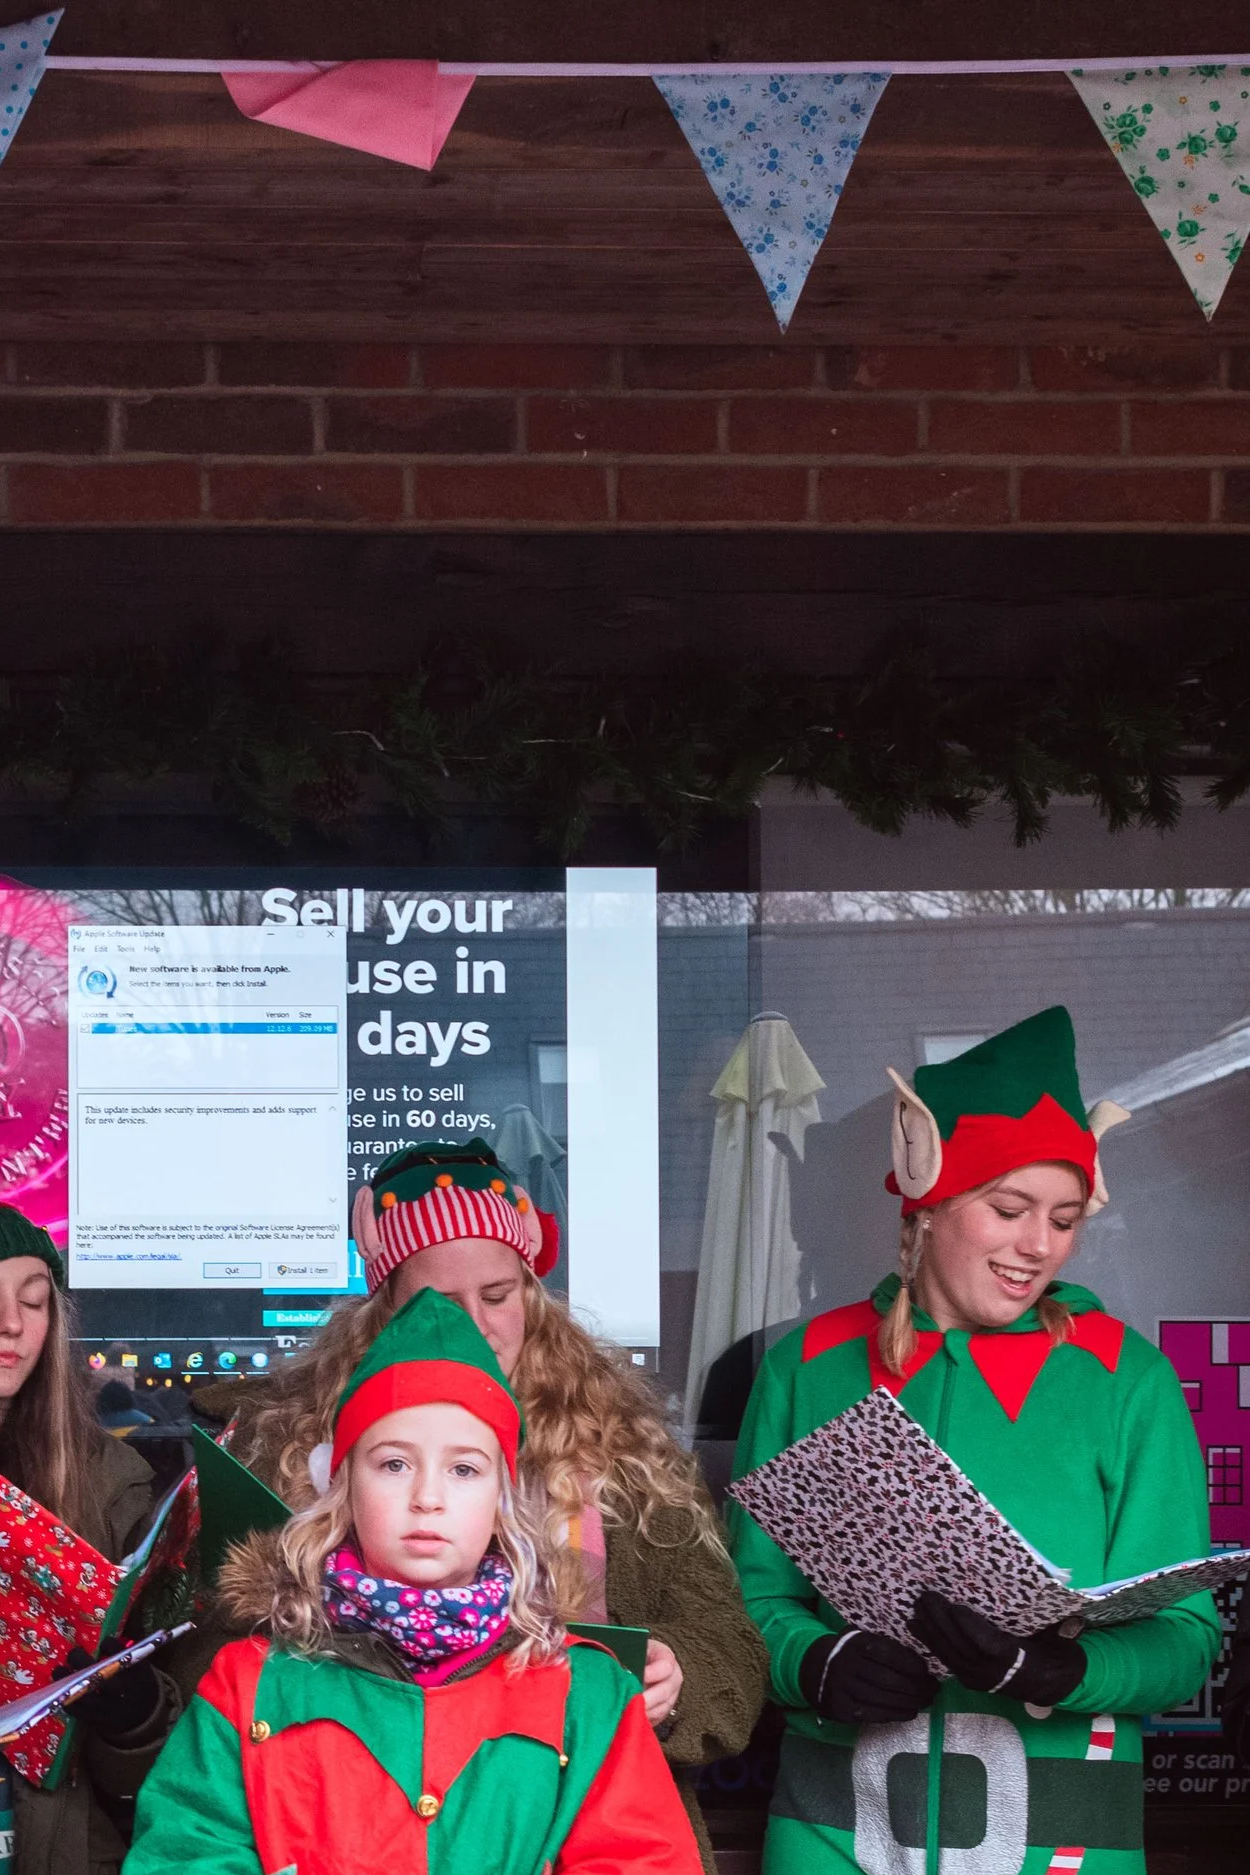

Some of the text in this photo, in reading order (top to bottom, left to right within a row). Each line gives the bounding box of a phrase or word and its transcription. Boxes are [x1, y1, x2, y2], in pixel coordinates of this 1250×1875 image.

[261, 888, 513, 945] Sell your
[85, 930, 165, 939] Apple Software Update
[144, 945, 161, 953] Help
[129, 965, 291, 975] New software is available from Apple.
[346, 946, 506, 994] use in
[181, 981, 194, 989] you
[357, 1010, 491, 1067] days
[373, 1087, 397, 1101] us
[402, 1085, 423, 1101] to
[429, 1084, 464, 1101] sell
[85, 1106, 317, 1116] This update includes security improvements and adds support
[85, 1117, 96, 1125] for
[117, 1117, 148, 1125] devices.
[382, 1110, 400, 1128] in
[406, 1109, 436, 1128] 60
[441, 1110, 496, 1132] days,
[296, 1225, 340, 1233] Agreement(s)
[92, 1233, 133, 1241] accompanied
[177, 1233, 195, 1241] being
[197, 1233, 225, 1241] updated.
[254, 1233, 272, 1241] Apple
[225, 1266, 239, 1275] Quit
[1152, 1754, 1235, 1769] or scan
[1144, 1778, 1250, 1799] ee our pr
